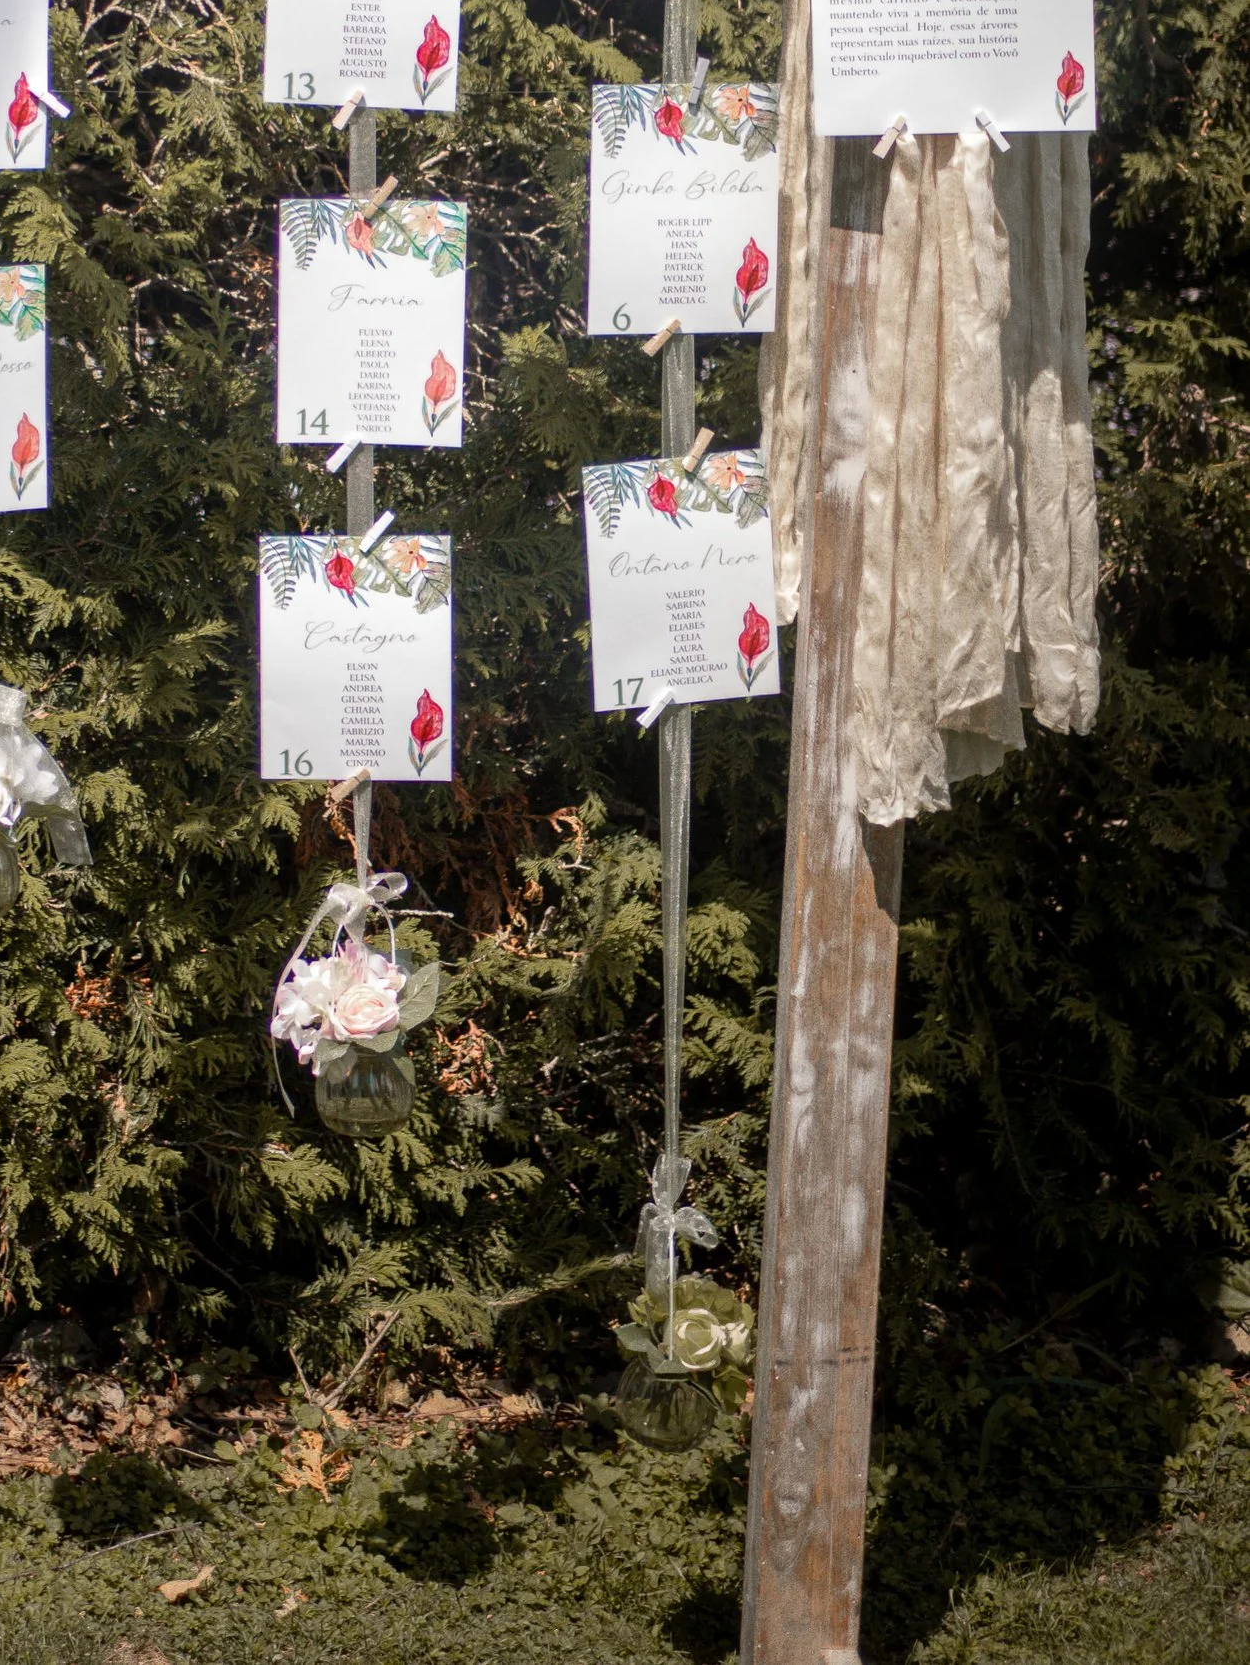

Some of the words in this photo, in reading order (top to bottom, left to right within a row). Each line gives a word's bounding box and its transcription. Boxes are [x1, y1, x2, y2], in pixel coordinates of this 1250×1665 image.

[343, 25, 386, 34] BARBARA
[343, 37, 386, 46] STEFANO
[340, 58, 387, 67] AUGUSTO
[284, 72, 316, 101] 13
[602, 170, 677, 204] Ginko
[685, 170, 765, 199] Biloba
[692, 218, 712, 226] LIPP
[666, 252, 703, 260] HELENA
[663, 274, 704, 282] WOLNEY
[327, 284, 423, 312] Farnia
[613, 303, 631, 331] 6
[355, 350, 396, 358] ALBERTO
[357, 382, 392, 391] KARINA
[297, 409, 329, 435] 14
[609, 551, 693, 578] Ontano
[701, 544, 760, 569] Nero
[666, 589, 705, 601] VALERIO
[666, 599, 706, 612] SABRINA
[669, 621, 705, 633] ELIABES
[305, 621, 417, 653] Castagno
[670, 653, 709, 666] SAMUEL
[613, 678, 645, 708] 17
[341, 717, 384, 725] CAMILLA
[280, 749, 313, 776] 16
